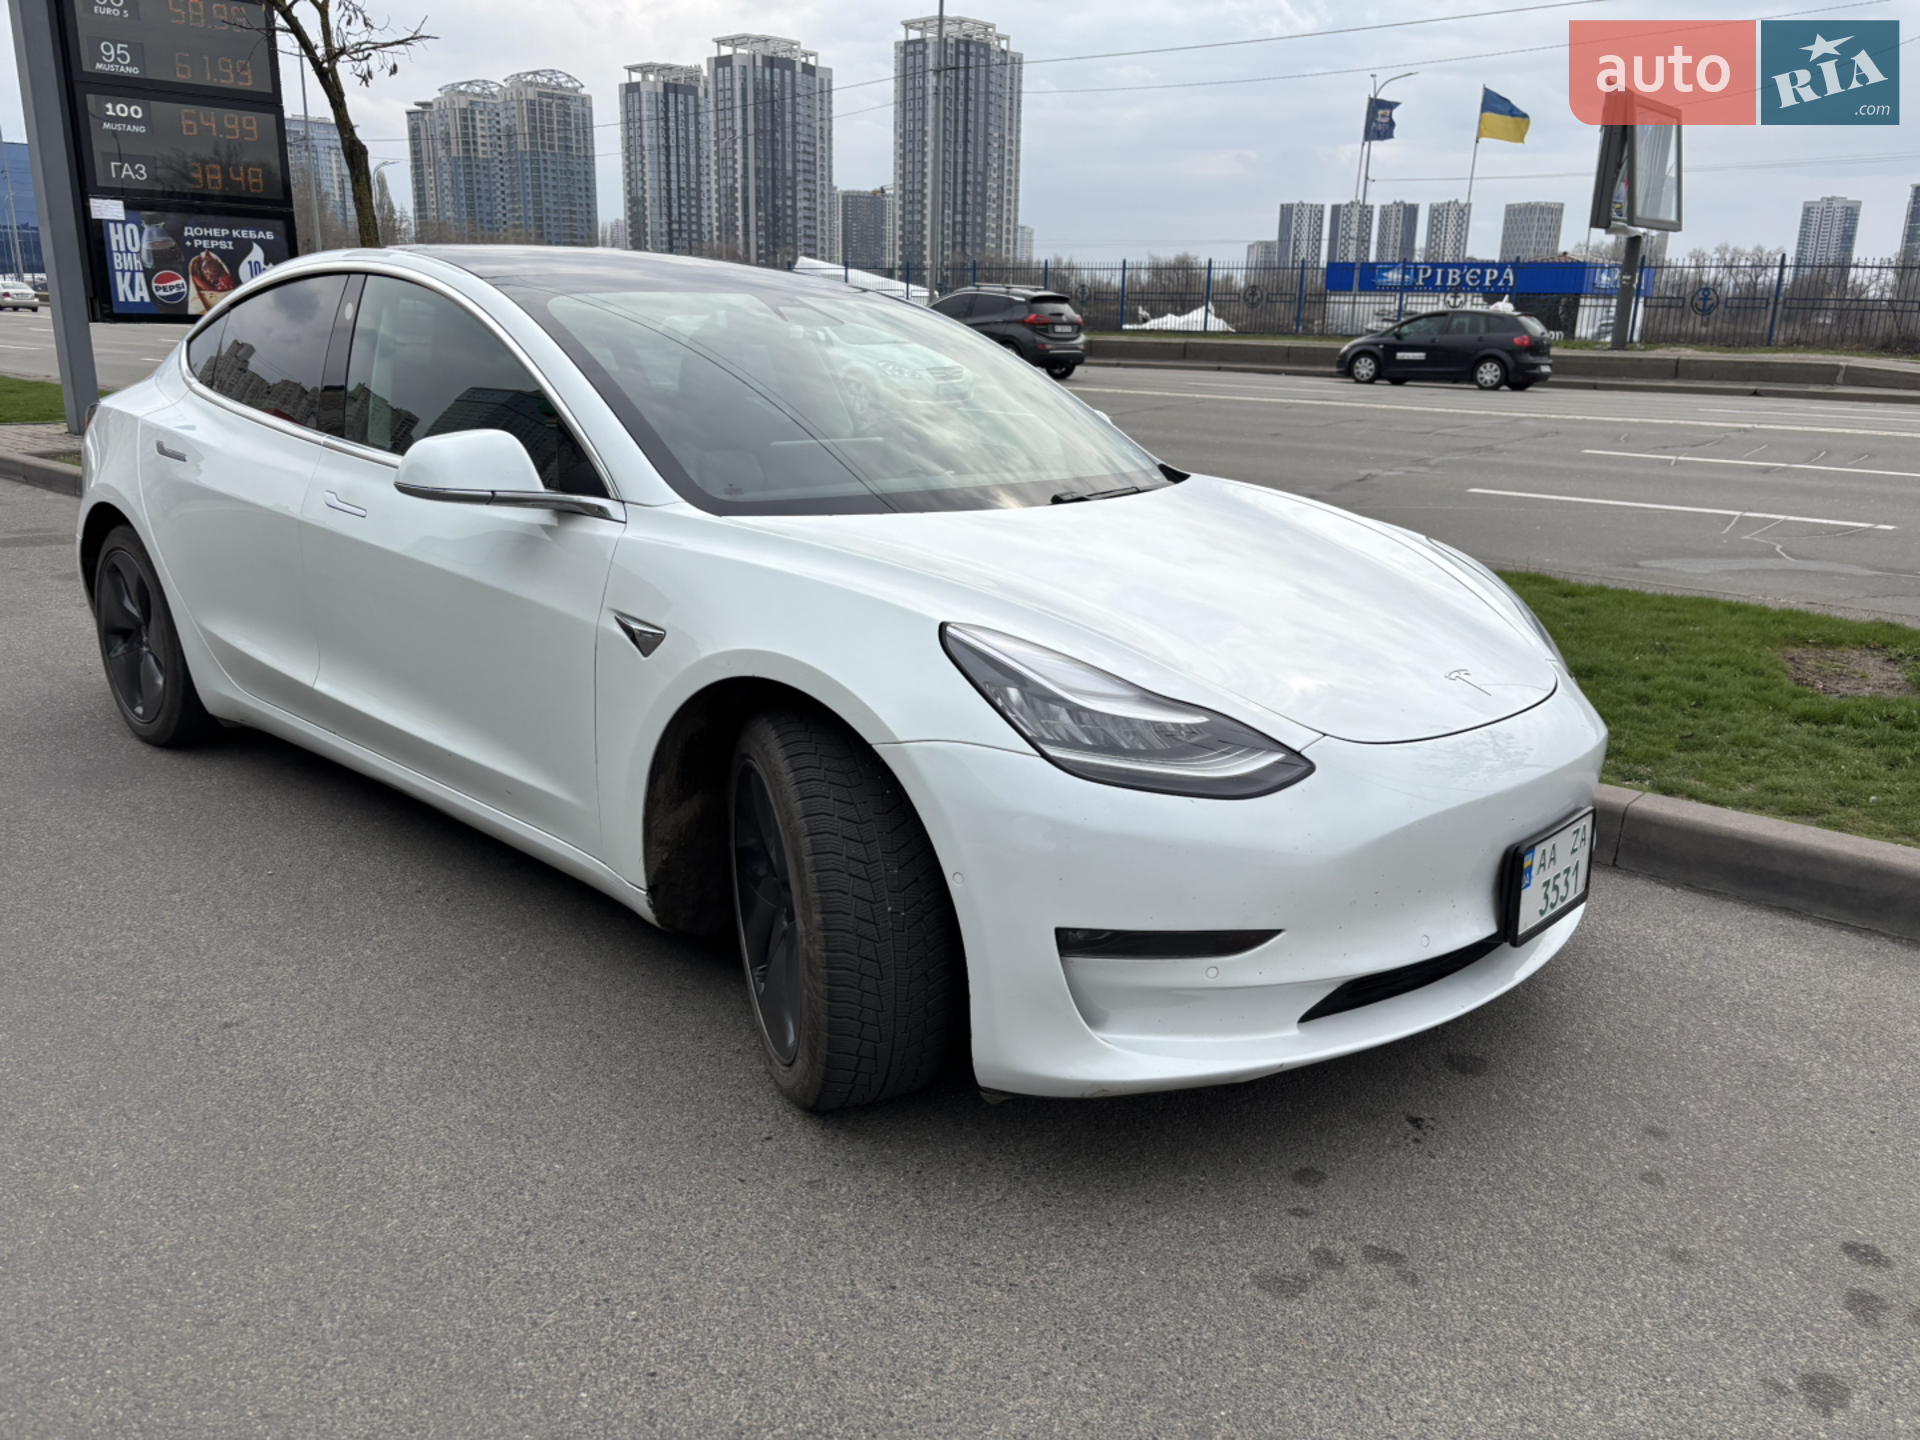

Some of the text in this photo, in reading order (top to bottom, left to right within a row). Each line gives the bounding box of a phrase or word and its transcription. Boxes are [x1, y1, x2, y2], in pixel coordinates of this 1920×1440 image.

[94, 5, 120, 17] EURO
[100, 41, 131, 64] 95
[95, 62, 140, 75] MUSTANG
[174, 51, 254, 87] 61.99
[105, 102, 143, 119] 100
[102, 121, 147, 134] MUSTANG
[181, 108, 259, 142] 64.99
[110, 161, 148, 181] ГАЗ
[187, 162, 264, 193] 38.48
[108, 222, 141, 253] НО
[184, 226, 275, 240] ДОНЕР КЕБАБ
[194, 239, 234, 250] PEPSI
[113, 252, 143, 271] ВИН
[115, 271, 151, 302] КА
[154, 282, 186, 293] PEPSI
[1536, 824, 1586, 875] AA ZA
[1538, 859, 1580, 916] 3531
